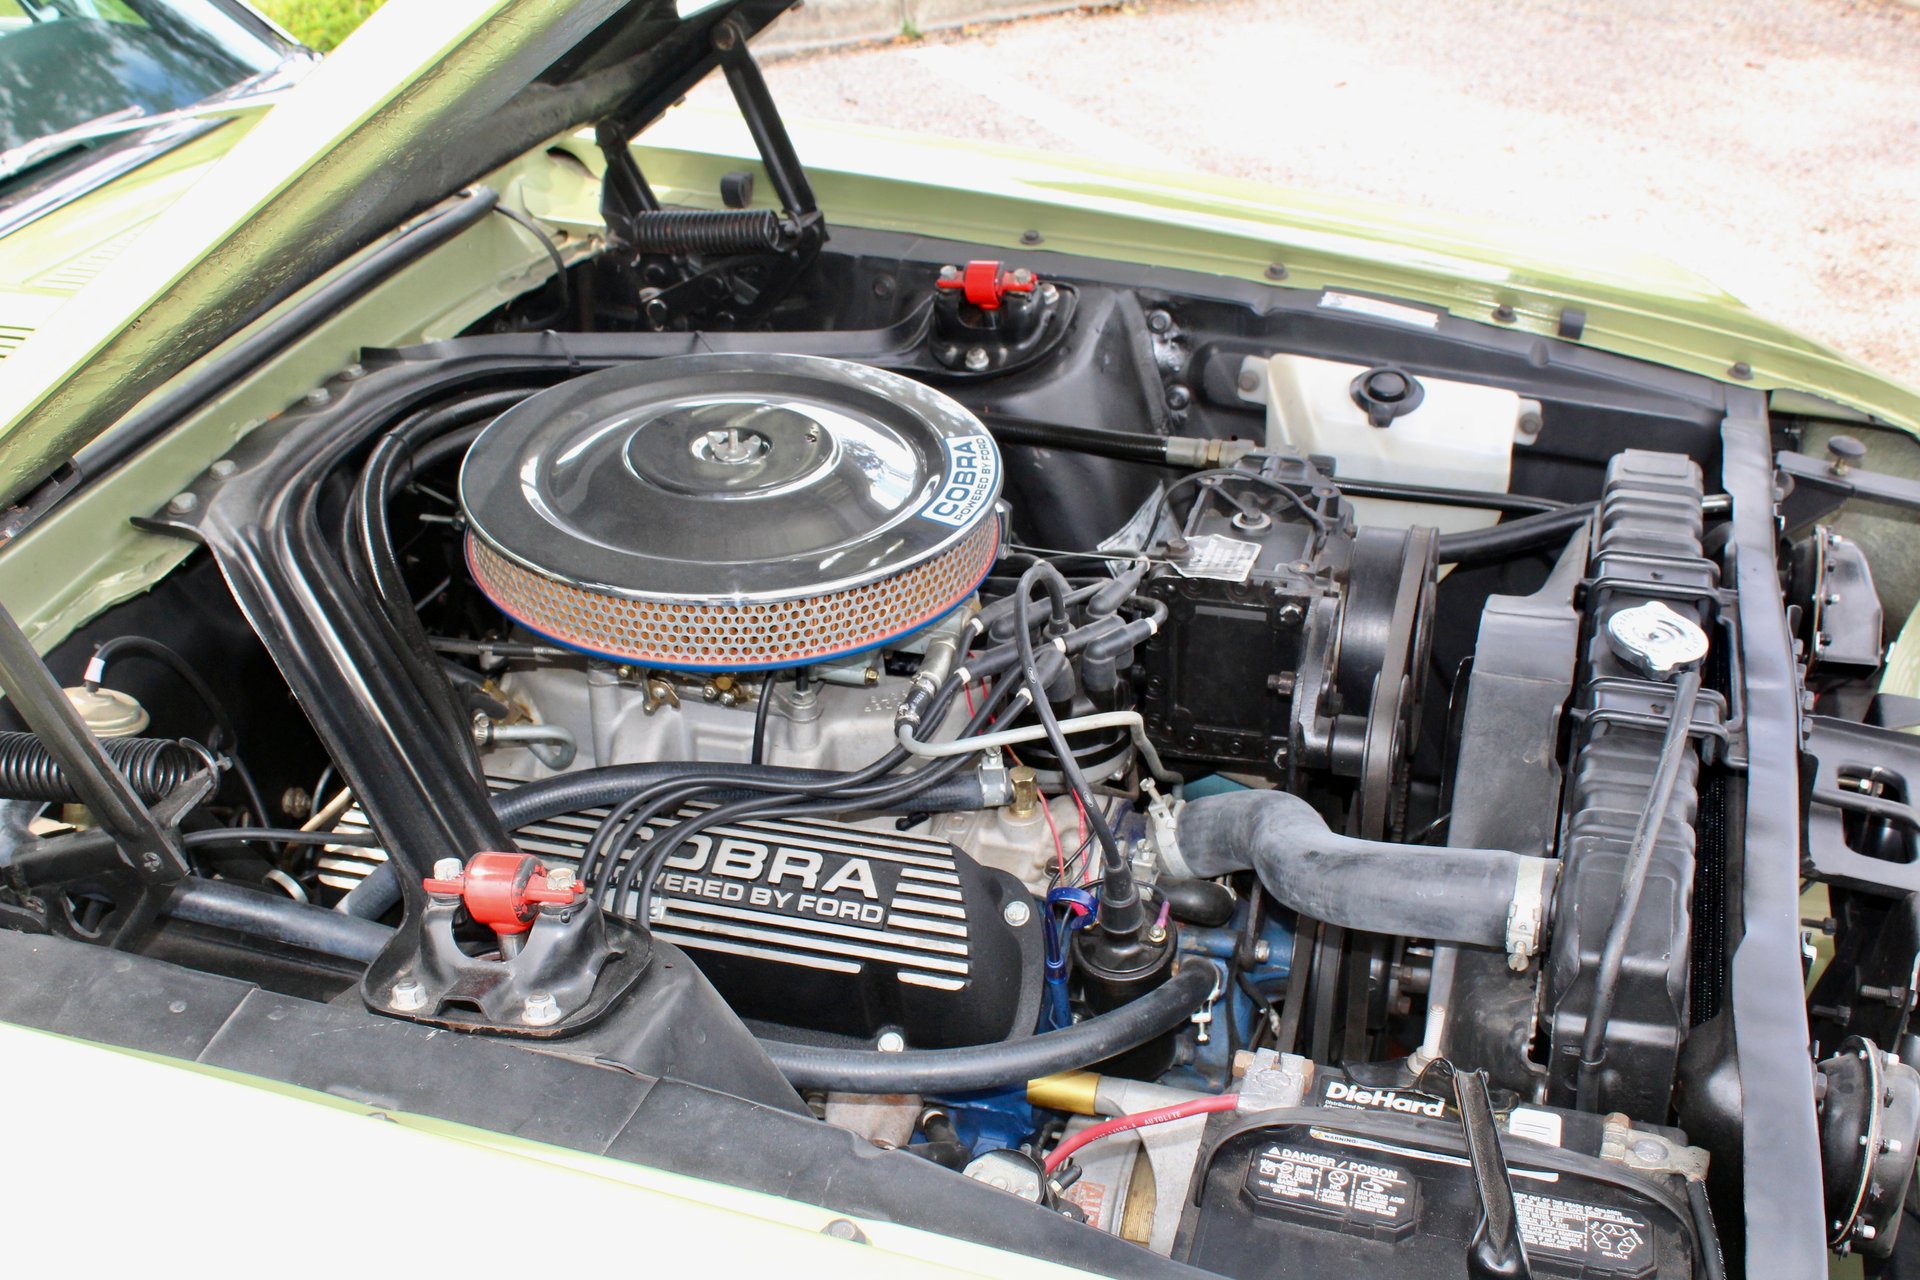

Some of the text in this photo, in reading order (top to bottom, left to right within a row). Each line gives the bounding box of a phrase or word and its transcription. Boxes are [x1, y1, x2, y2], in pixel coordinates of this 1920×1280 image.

[932, 441, 977, 517] COBRA
[954, 438, 991, 520] POWERED BY FORD
[750, 886, 793, 909] BY
[797, 895, 884, 924] FORD
[1326, 1081, 1446, 1118] DieHard
[1144, 1111, 1181, 1125] AUTOLITE
[1324, 1134, 1358, 1144] WARNING:
[1282, 1148, 1336, 1167] DANGER
[1349, 1162, 1398, 1179] POISON
[1330, 1183, 1341, 1191] NO
[1389, 1196, 1405, 1204] ACID
[1602, 1251, 1628, 1260] RECYCLE
